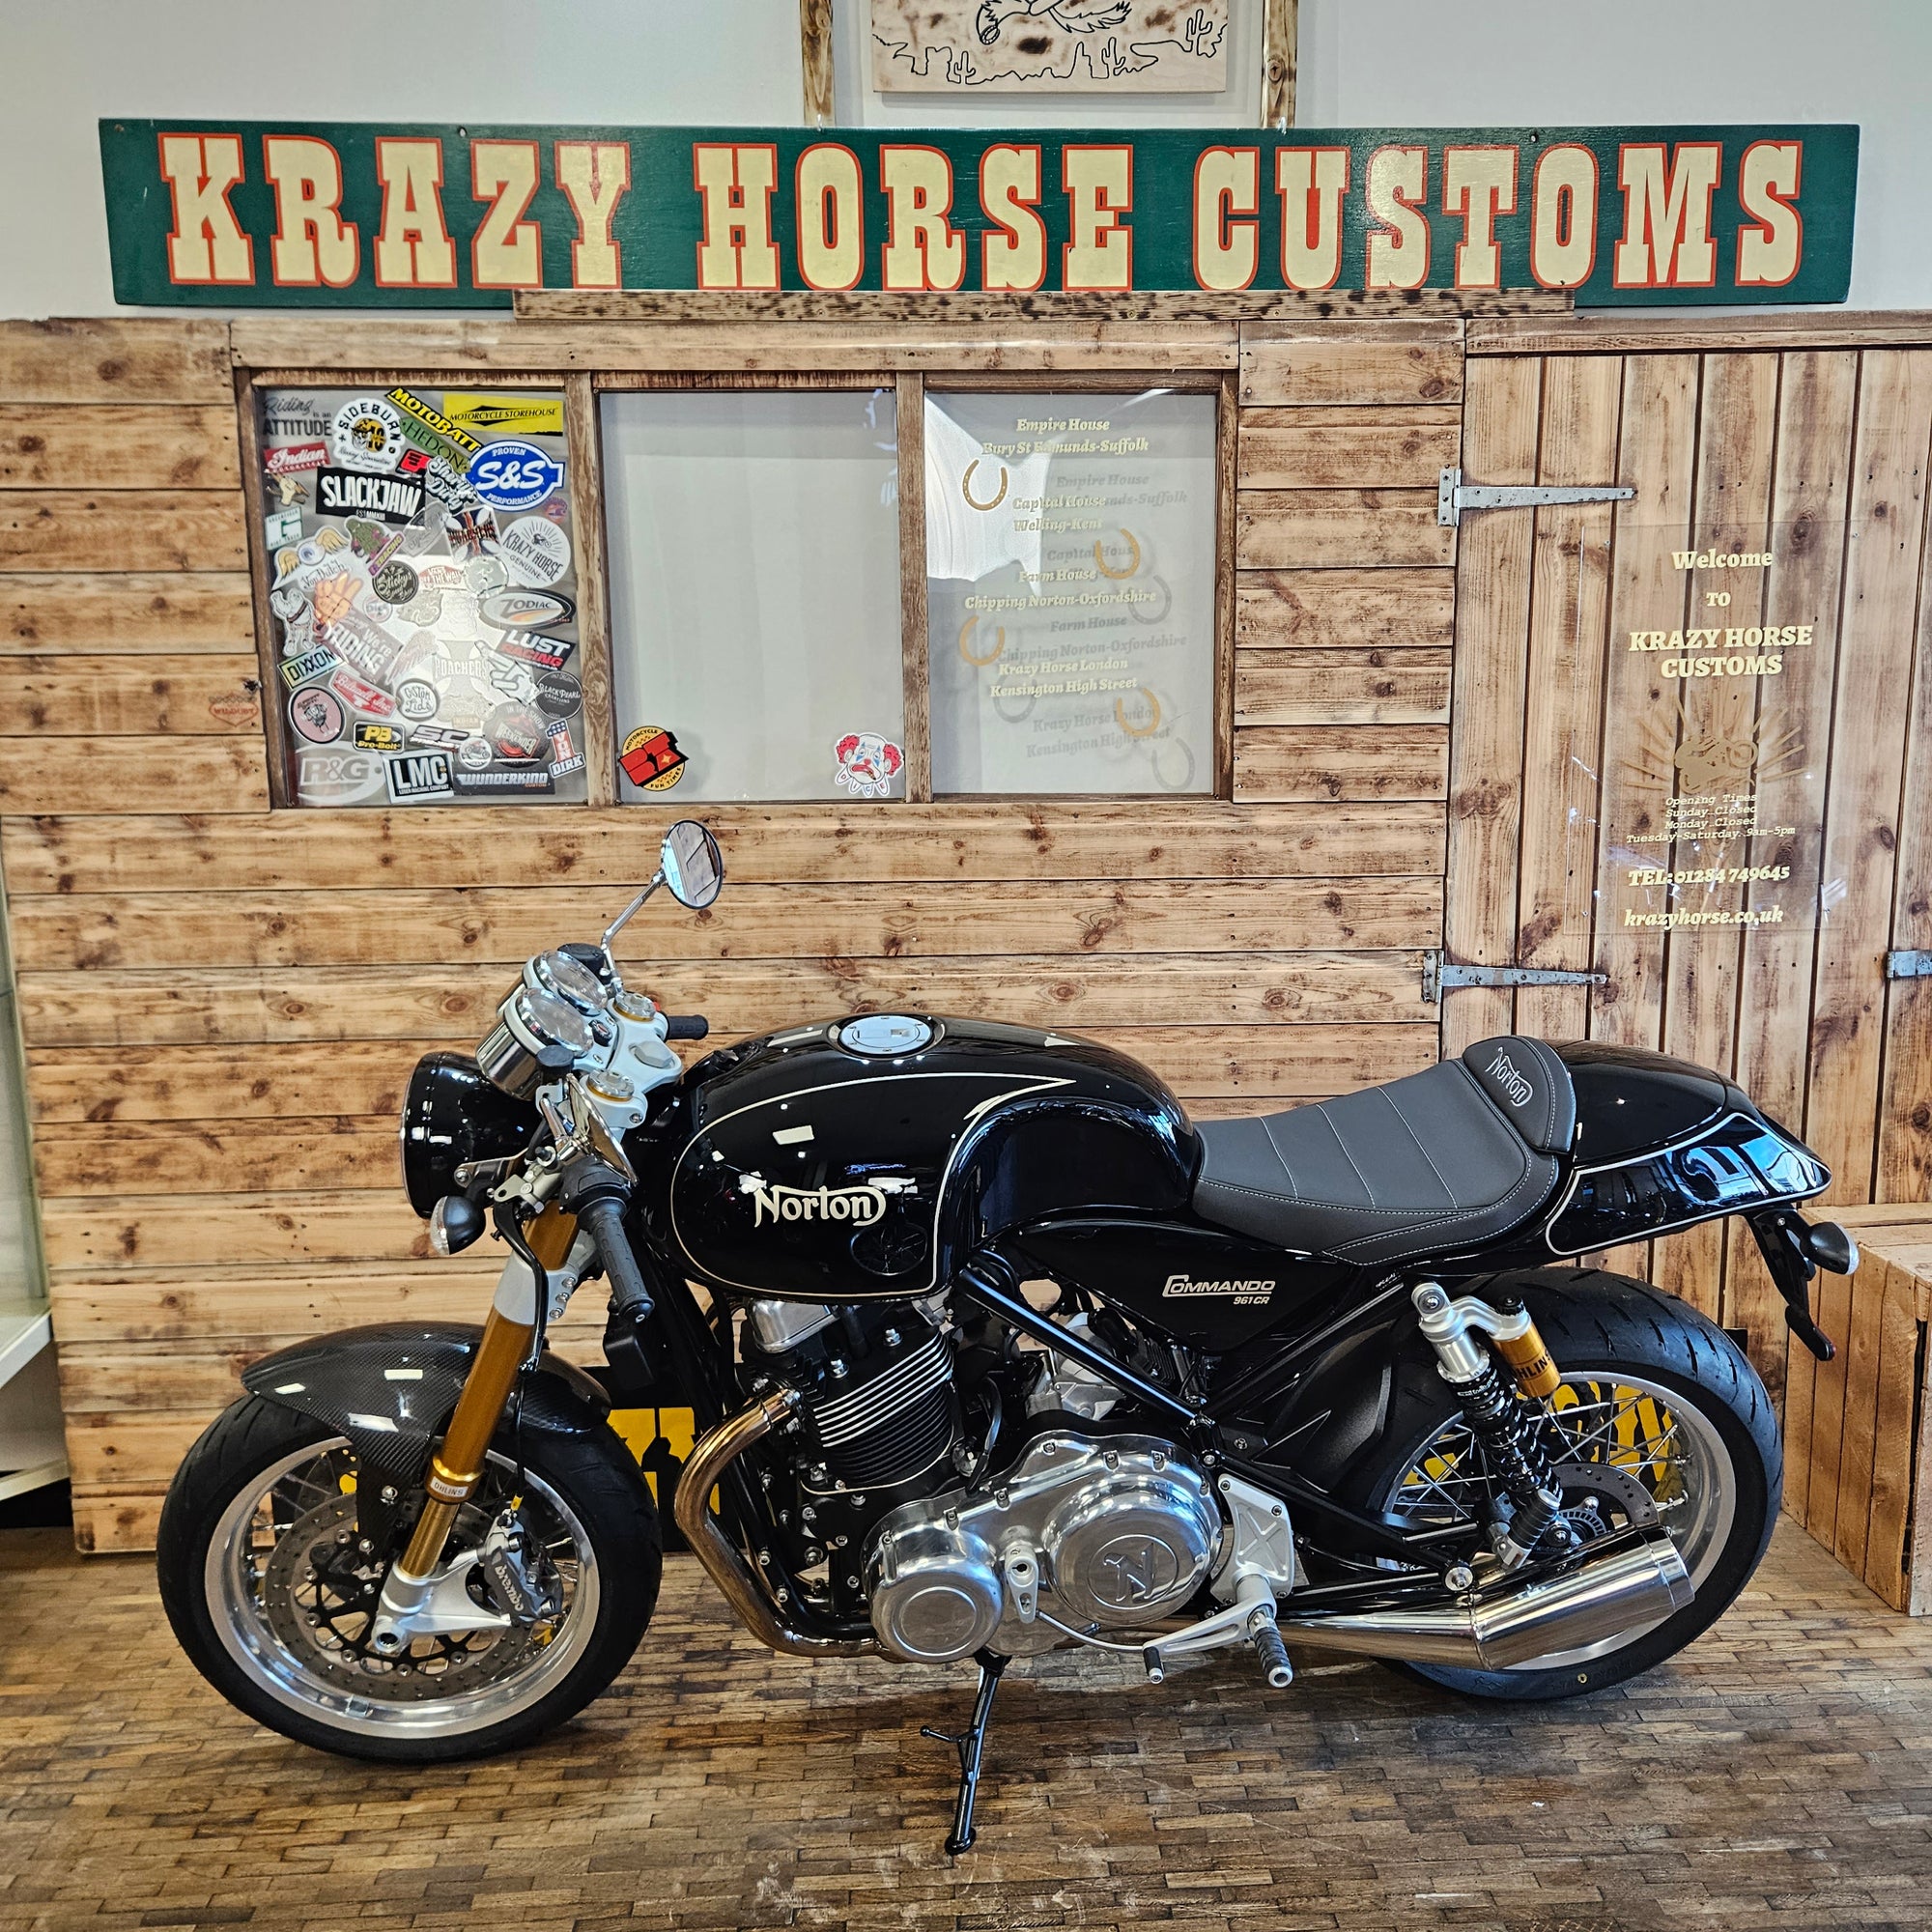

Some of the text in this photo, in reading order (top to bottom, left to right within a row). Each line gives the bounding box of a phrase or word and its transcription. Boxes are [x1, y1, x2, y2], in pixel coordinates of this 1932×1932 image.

[157, 132, 1803, 291] KRAZY HORSE CUSTOMS
[265, 396, 315, 416] Riding
[449, 408, 558, 421] MOTORCYCLE STOREHOUSE
[263, 418, 332, 437] ATTITUDE
[338, 402, 402, 441] SIDEBURN
[390, 387, 482, 452] MOTOBATT
[1015, 417, 1110, 435] Empire House
[405, 421, 464, 469] HEDON
[492, 446, 526, 457] PROVEN
[982, 441, 1015, 458] Bury
[1016, 440, 1032, 454] St
[268, 448, 327, 467] Indian
[475, 460, 547, 491] S&S
[321, 475, 422, 517] SLACKJAW
[486, 490, 543, 506] PERFORMANCE
[1013, 496, 1064, 512] Capital
[502, 529, 535, 558] KRAZY
[531, 552, 563, 582] HORSE
[1671, 549, 1774, 570] Welcome
[509, 554, 542, 580] GENUINE
[1019, 568, 1097, 582] Farm House
[500, 598, 553, 619] ZODIAC
[965, 595, 1027, 611] Chipping
[505, 630, 571, 657] LUST
[1628, 625, 1814, 652] KRAZY HORSE
[287, 649, 336, 681] DIXXON
[501, 643, 564, 668] RACING
[1661, 654, 1784, 678] CUSTOMS
[998, 657, 1128, 677] Krazy Horse London
[538, 682, 559, 696] BLACK
[989, 676, 1138, 698] Kensington High Street
[364, 725, 391, 742] PB
[414, 725, 469, 745] SC
[625, 728, 659, 751] MOTORCYCLE
[357, 741, 400, 752] Pro-Bolt
[555, 734, 573, 758] VON
[302, 757, 370, 783] R&G
[392, 755, 448, 788] LMC
[551, 756, 584, 774] DIRK
[456, 773, 549, 785] WUNDERKIND
[1664, 793, 1758, 809] Opening Times
[1674, 867, 1726, 884] 01284
[1727, 866, 1791, 883] 749645
[1624, 904, 1784, 930] krazyhorse.co.uk
[1485, 1046, 1533, 1107] Norton
[753, 1184, 887, 1228] Norton
[1162, 1274, 1276, 1297] COMMANDO
[494, 1564, 525, 1612] brembo
